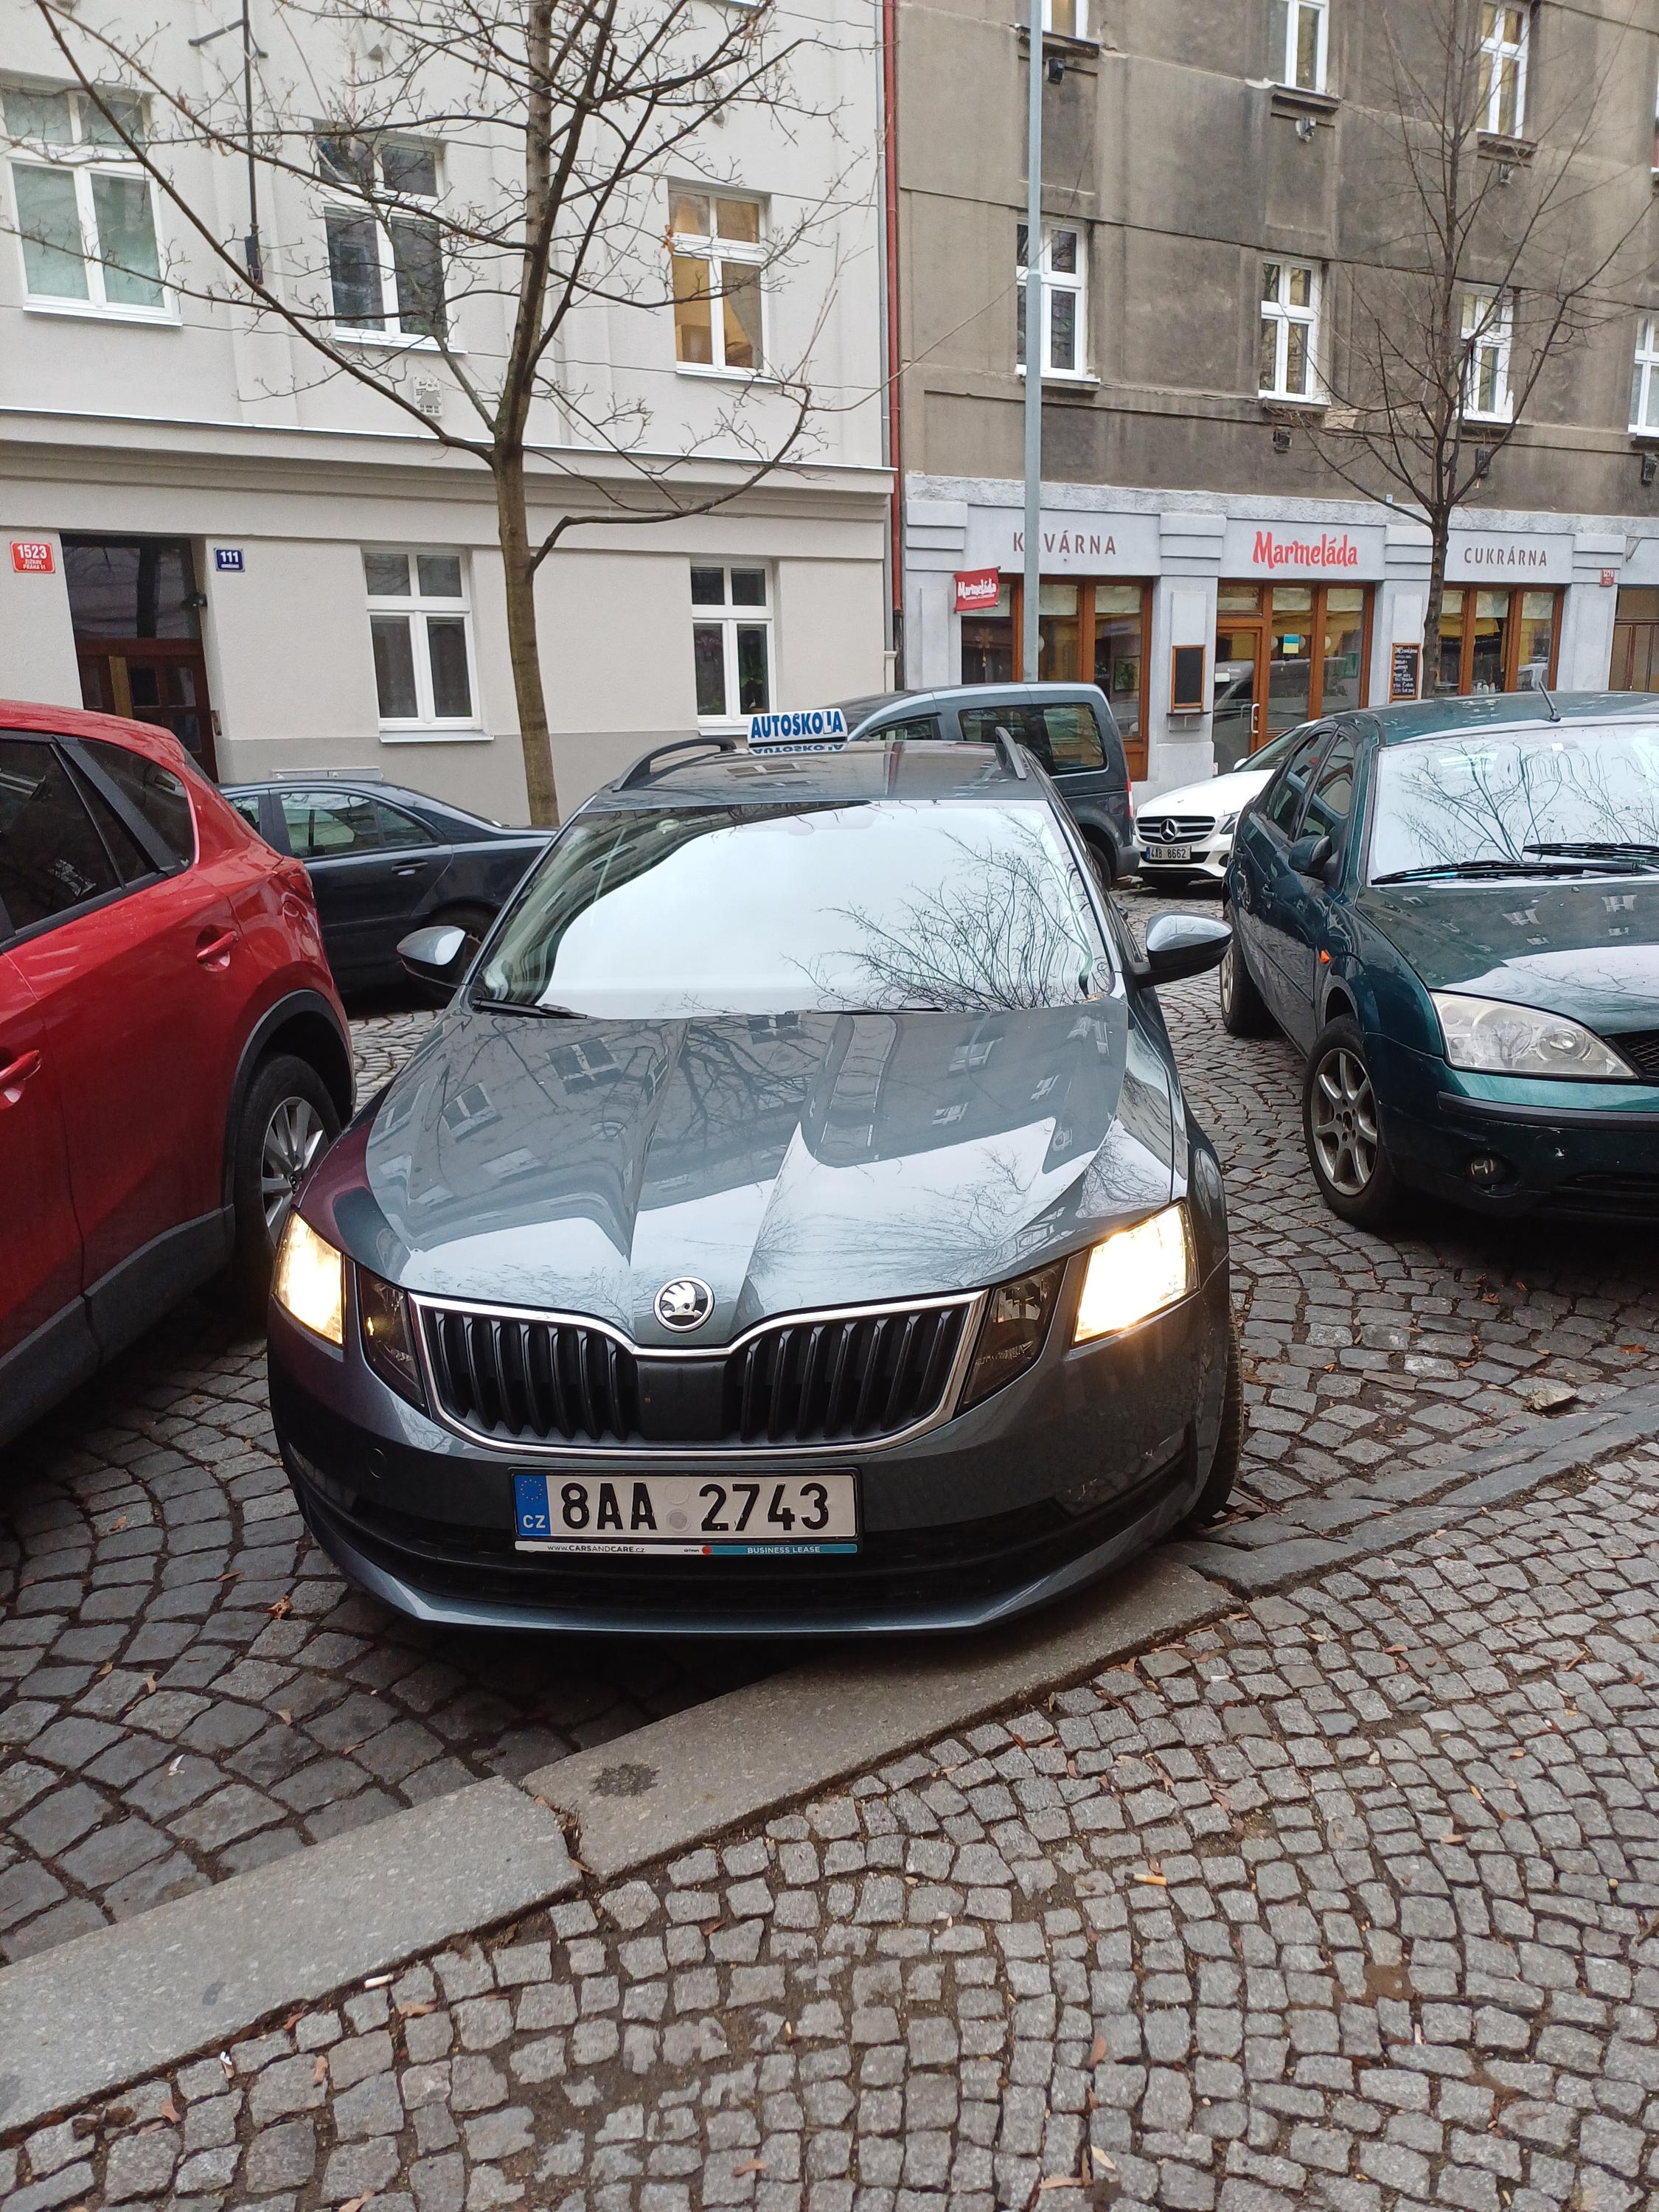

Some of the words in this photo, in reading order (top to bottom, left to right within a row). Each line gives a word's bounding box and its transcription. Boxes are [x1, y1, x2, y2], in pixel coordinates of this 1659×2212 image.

[1013, 529, 1116, 554] KVÁRNA
[1253, 530, 1358, 569] Marmeláda
[17, 544, 47, 560] 1523
[220, 551, 239, 563] 111
[1464, 546, 1547, 567] CUKRÁRNA
[1151, 848, 1163, 858] 4AB
[1167, 848, 1186, 858] 8662
[560, 1482, 658, 1530] 8AA
[699, 1482, 830, 1531] 2743
[523, 1514, 546, 1528] CZ
